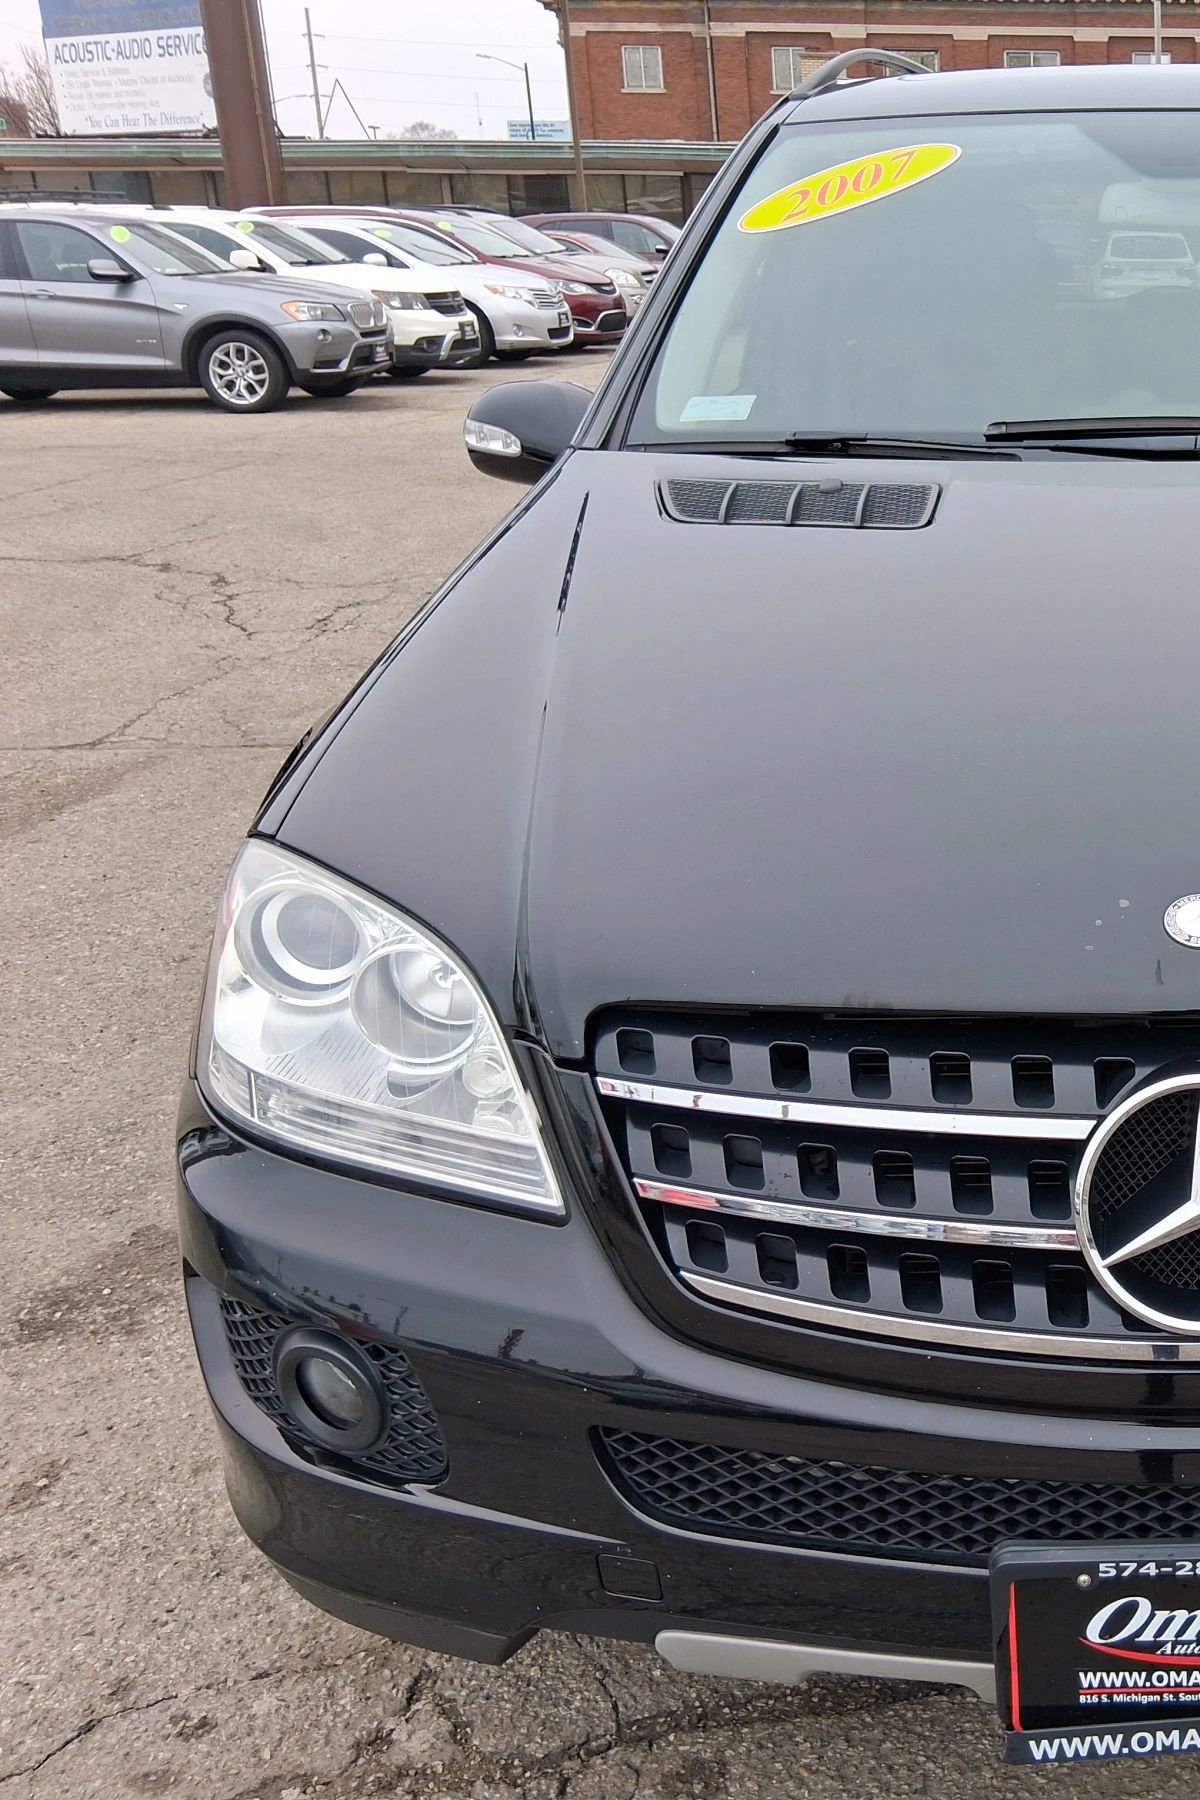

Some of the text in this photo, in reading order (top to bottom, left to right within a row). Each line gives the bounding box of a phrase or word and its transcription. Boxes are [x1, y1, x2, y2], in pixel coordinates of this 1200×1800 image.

[104, 114, 119, 128] Can
[121, 113, 139, 127] Hear
[142, 112, 157, 126] The
[781, 150, 917, 223] 2007
[1079, 1693, 1098, 1703] 816
[1101, 1693, 1111, 1703] S.
[1113, 1692, 1160, 1704] Michigan
[1163, 1692, 1176, 1702] St.
